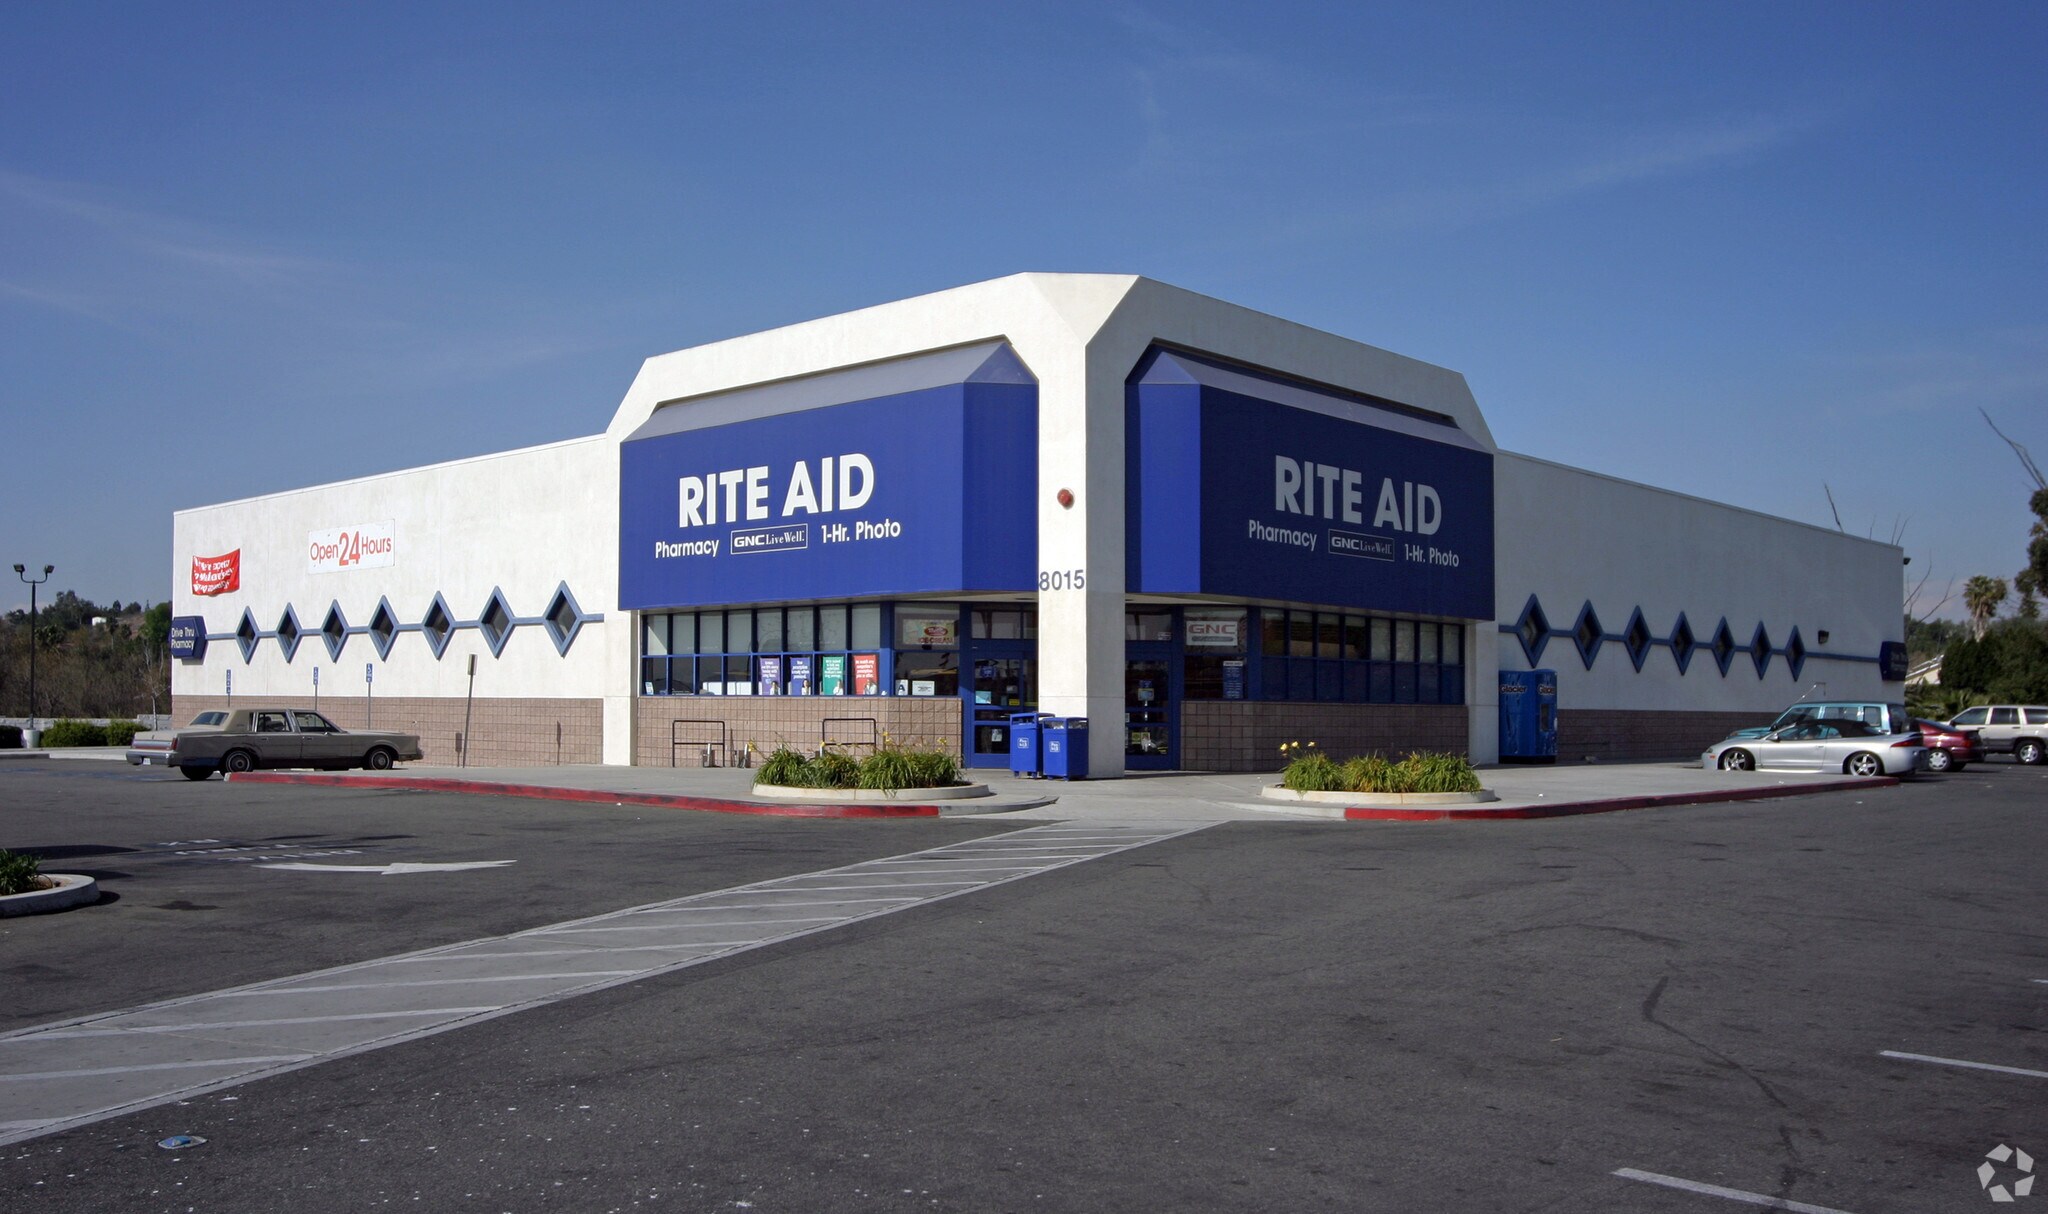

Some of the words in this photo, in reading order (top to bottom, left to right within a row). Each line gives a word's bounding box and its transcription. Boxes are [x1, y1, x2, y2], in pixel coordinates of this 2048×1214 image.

[679, 466, 769, 528] RITE
[782, 453, 875, 517] AID
[1275, 455, 1362, 525] RITE
[1373, 477, 1442, 536] AID
[310, 542, 339, 565] Open
[338, 530, 361, 567] 24
[361, 535, 392, 556] Hours
[655, 539, 720, 559] Pharmacy
[733, 534, 766, 548] GNC
[821, 523, 850, 544] 1-Hr.
[855, 518, 901, 541] Photo
[1248, 519, 1318, 552] Pharmacy
[1331, 536, 1360, 551] GNC
[1404, 543, 1426, 563] 1-Hr.
[1429, 547, 1460, 568] Photo
[1039, 569, 1085, 591] 8015
[171, 627, 184, 638] Drive
[184, 626, 195, 637] Thru
[171, 638, 195, 651] Pharmacy
[1188, 624, 1236, 634] GNC
